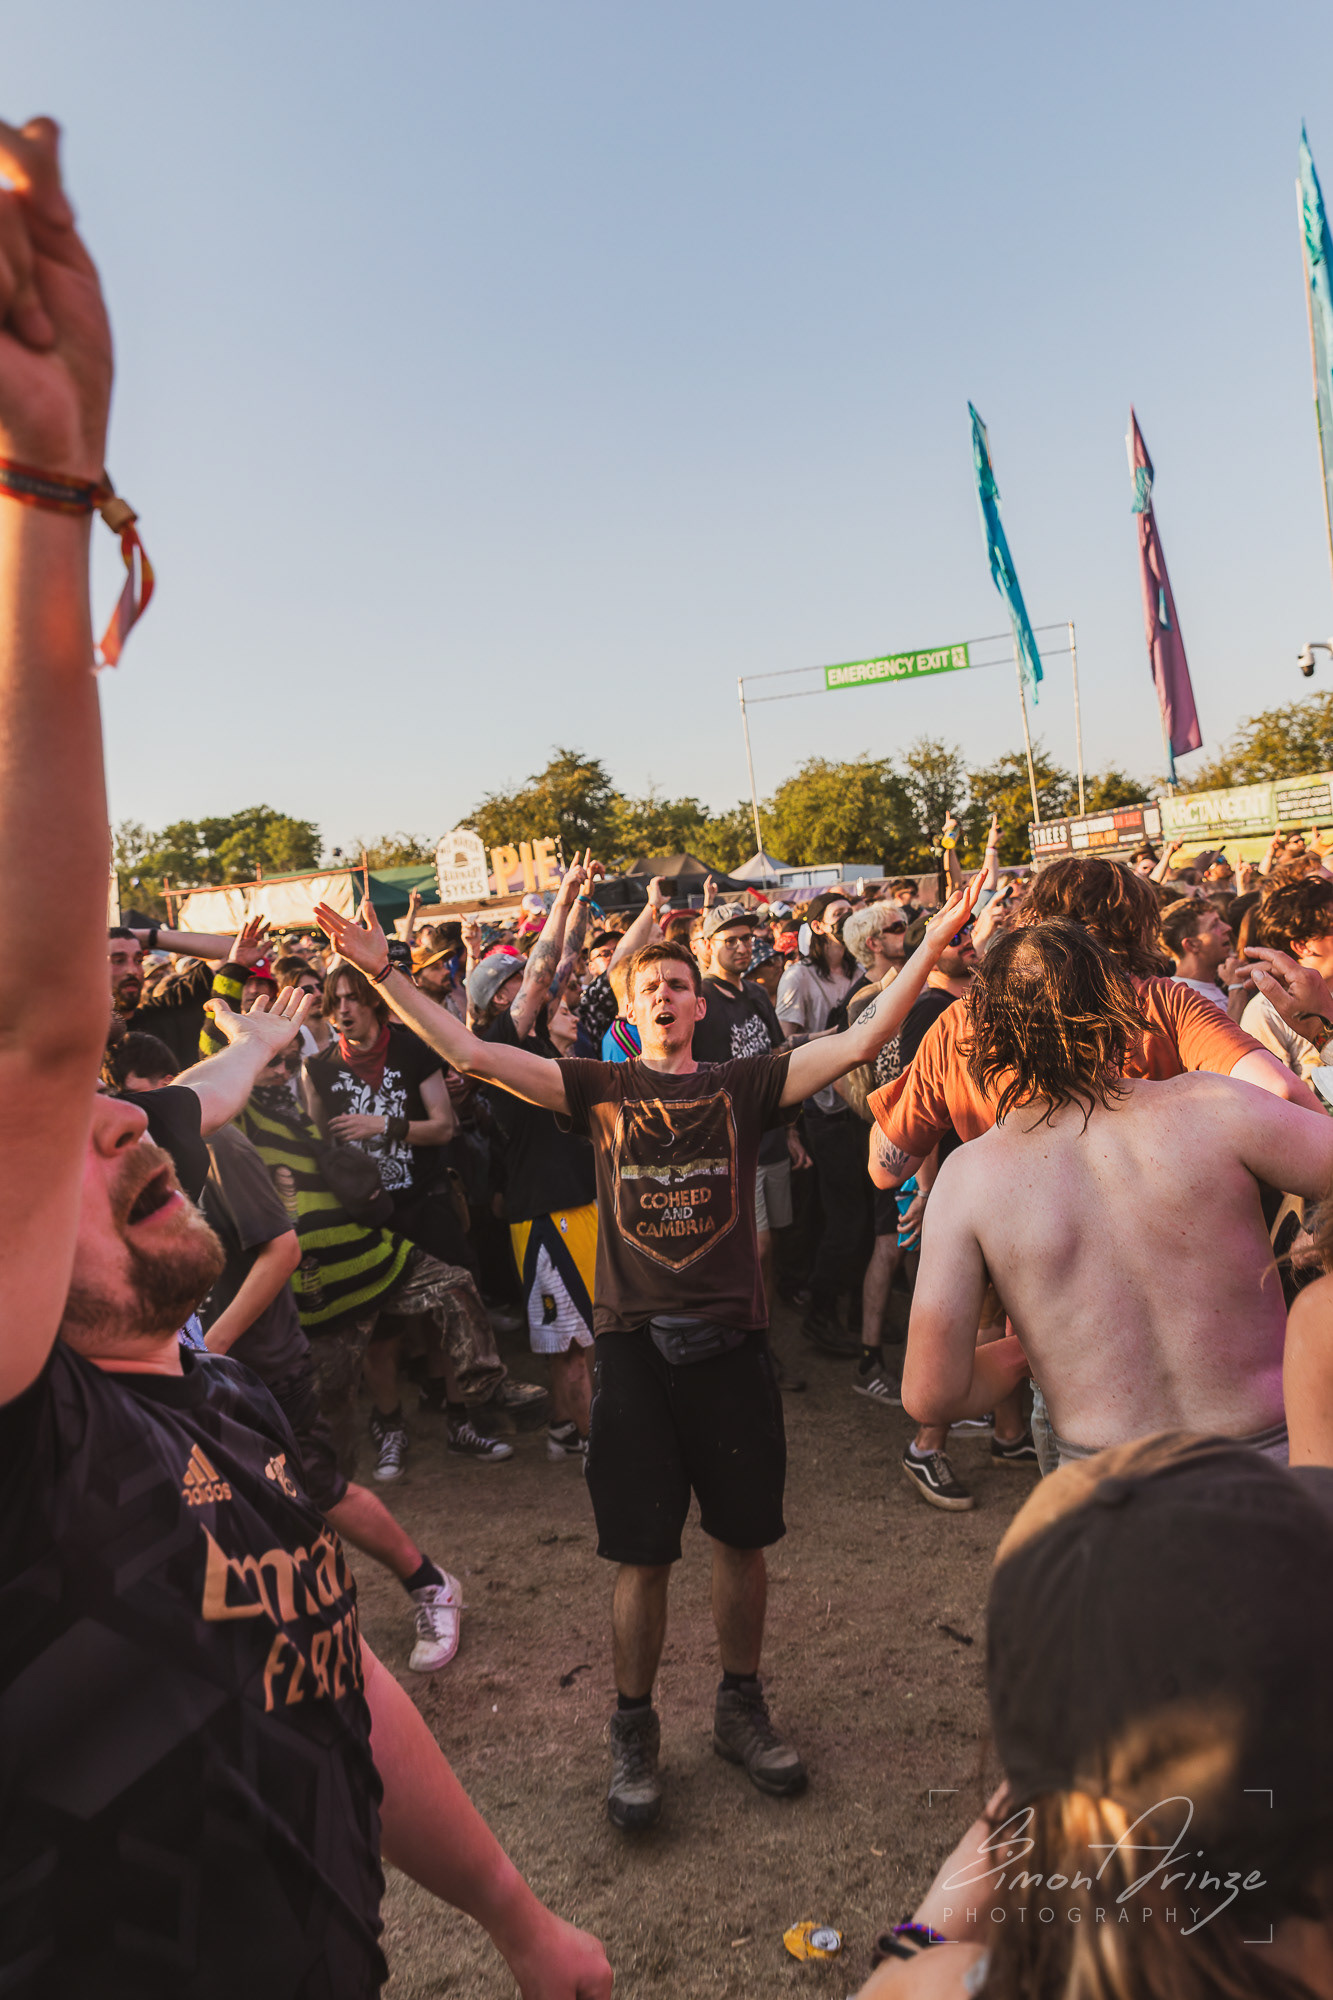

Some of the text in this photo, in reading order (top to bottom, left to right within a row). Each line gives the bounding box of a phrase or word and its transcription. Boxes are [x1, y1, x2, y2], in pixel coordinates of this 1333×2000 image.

[827, 650, 950, 686] EMERGENCY EXIT
[1033, 825, 1068, 846] TREES
[490, 838, 561, 898] PIE
[445, 880, 484, 897] SYKES
[639, 1187, 712, 1210] COHEED
[661, 1206, 693, 1221] AND
[636, 1216, 716, 1238] CAMBRIA
